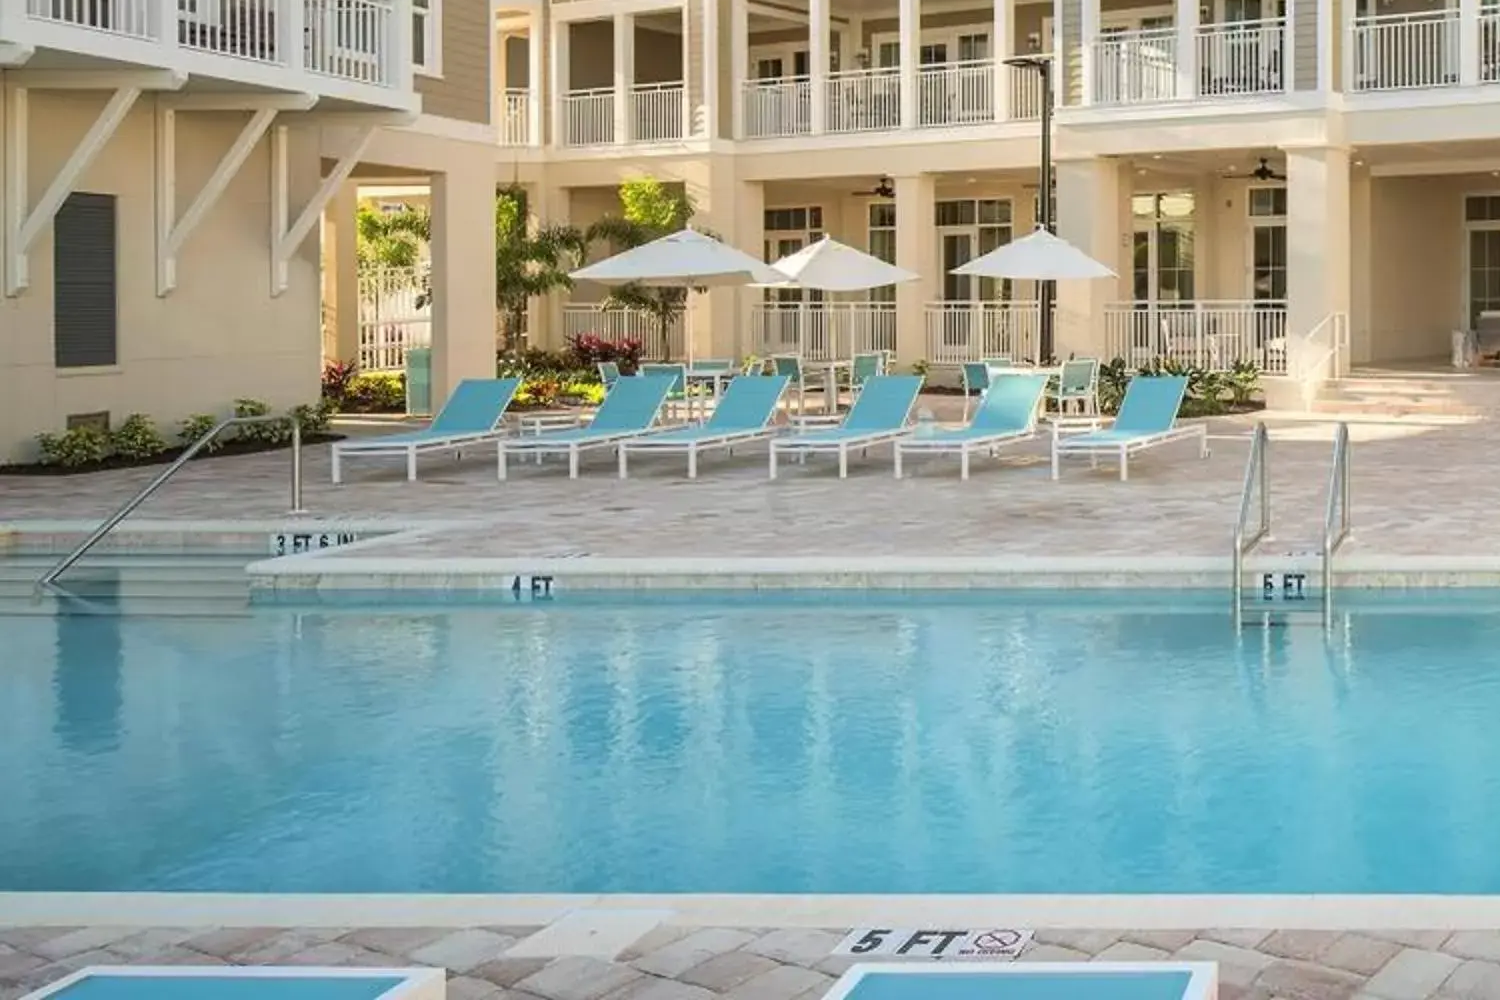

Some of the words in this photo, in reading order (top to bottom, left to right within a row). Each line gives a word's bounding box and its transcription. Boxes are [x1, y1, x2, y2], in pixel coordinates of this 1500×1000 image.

[532, 575, 553, 592] FT
[1283, 574, 1305, 591] FT
[851, 929, 893, 953] 5
[896, 930, 968, 954] FT
